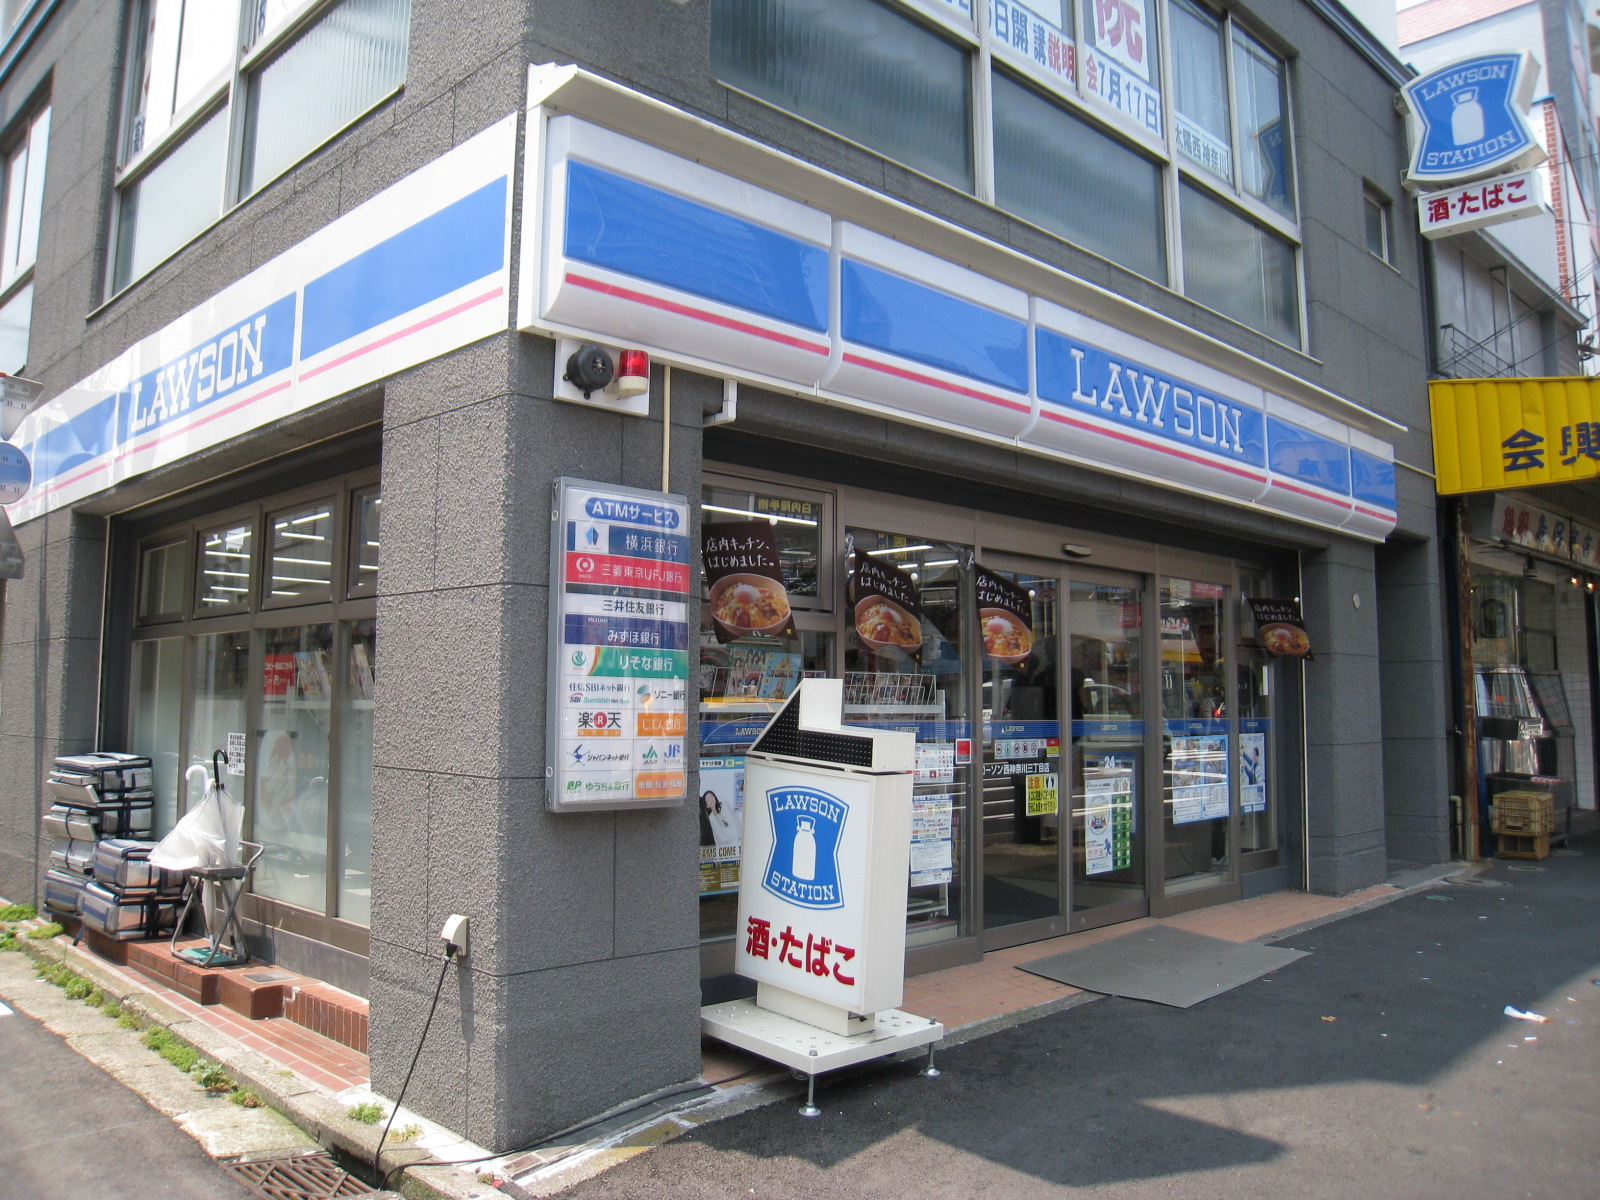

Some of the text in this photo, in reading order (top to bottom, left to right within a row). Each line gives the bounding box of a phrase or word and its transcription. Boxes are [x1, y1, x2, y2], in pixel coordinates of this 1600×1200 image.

[1421, 64, 1508, 100] LAWSON
[1426, 130, 1517, 166] STATION
[1428, 179, 1527, 222] 酒・たばこ
[130, 315, 266, 433] LAWSON
[1071, 348, 1244, 454] LAWSON
[592, 501, 675, 526] ATMサービス
[625, 534, 678, 556] 横浜銀行
[708, 554, 775, 568] はじめました。
[602, 564, 682, 584] 三菱東京UFJ銀行
[603, 600, 664, 616] 三井住友銀行
[607, 630, 660, 645] みずほ銀行
[619, 655, 673, 672] りそな銀行
[569, 683, 630, 692] 住信SBIネット銀行
[654, 690, 686, 700] ソニー銀行
[642, 719, 681, 730] じぶん銀行
[1104, 756, 1115, 768] 24
[585, 781, 629, 791] ゆうちょ銀行
[774, 796, 841, 824] LAWSON
[719, 846, 736, 857] COME
[771, 871, 836, 901] STATION
[746, 916, 855, 986] 酒・たばこ
